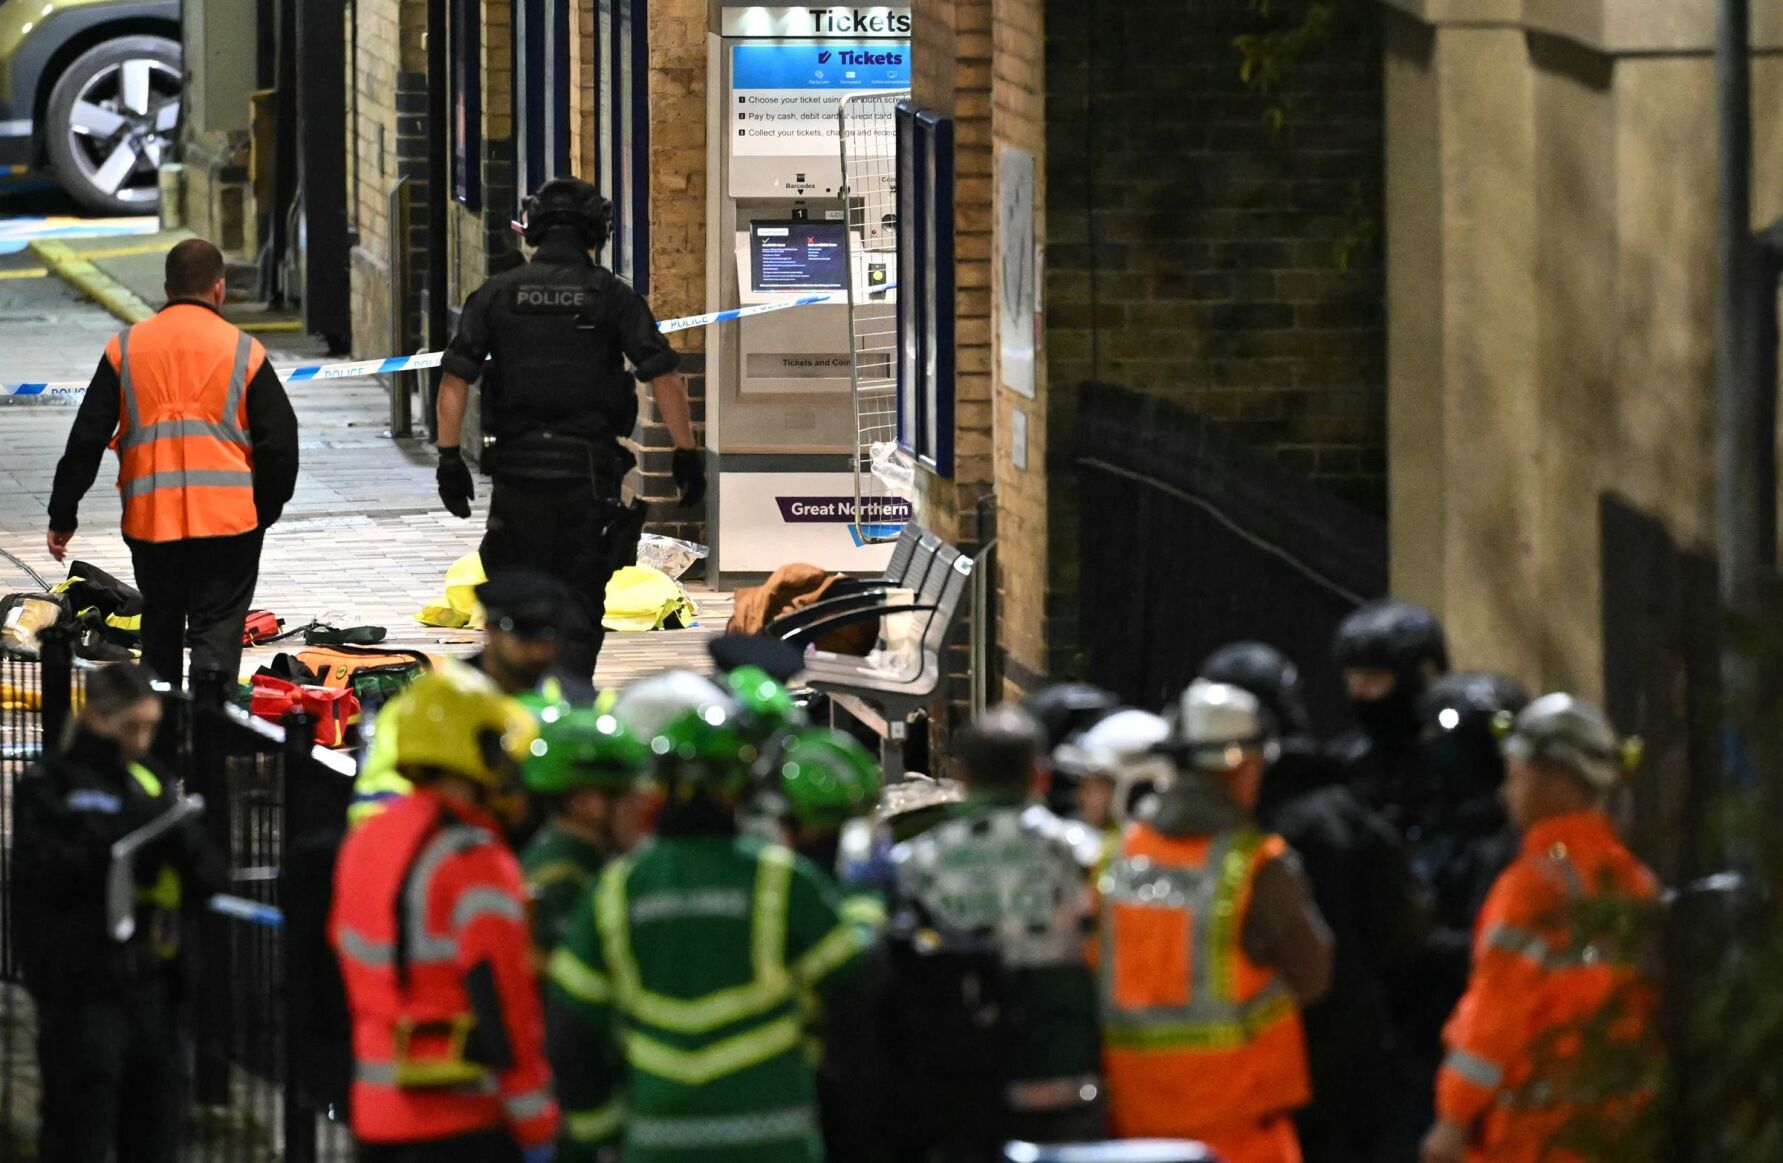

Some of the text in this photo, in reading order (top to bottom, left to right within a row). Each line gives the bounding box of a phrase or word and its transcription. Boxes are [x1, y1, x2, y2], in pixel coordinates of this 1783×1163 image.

[809, 10, 911, 33] Tickets
[838, 51, 903, 65] Tickets
[748, 96, 779, 104] Choose
[780, 97, 798, 105] your
[800, 96, 821, 104] ticket
[748, 113, 763, 121] Pay
[766, 113, 775, 121] by
[800, 112, 820, 120] debit
[748, 129, 775, 137] Collect
[797, 129, 824, 137] tickets,
[826, 130, 856, 139] chage
[517, 291, 585, 306] POLICE
[670, 315, 708, 330] POLICE
[782, 358, 813, 367] Tickets
[814, 358, 830, 367] and
[324, 367, 365, 379] POLICE
[791, 502, 909, 516] Great Northern
